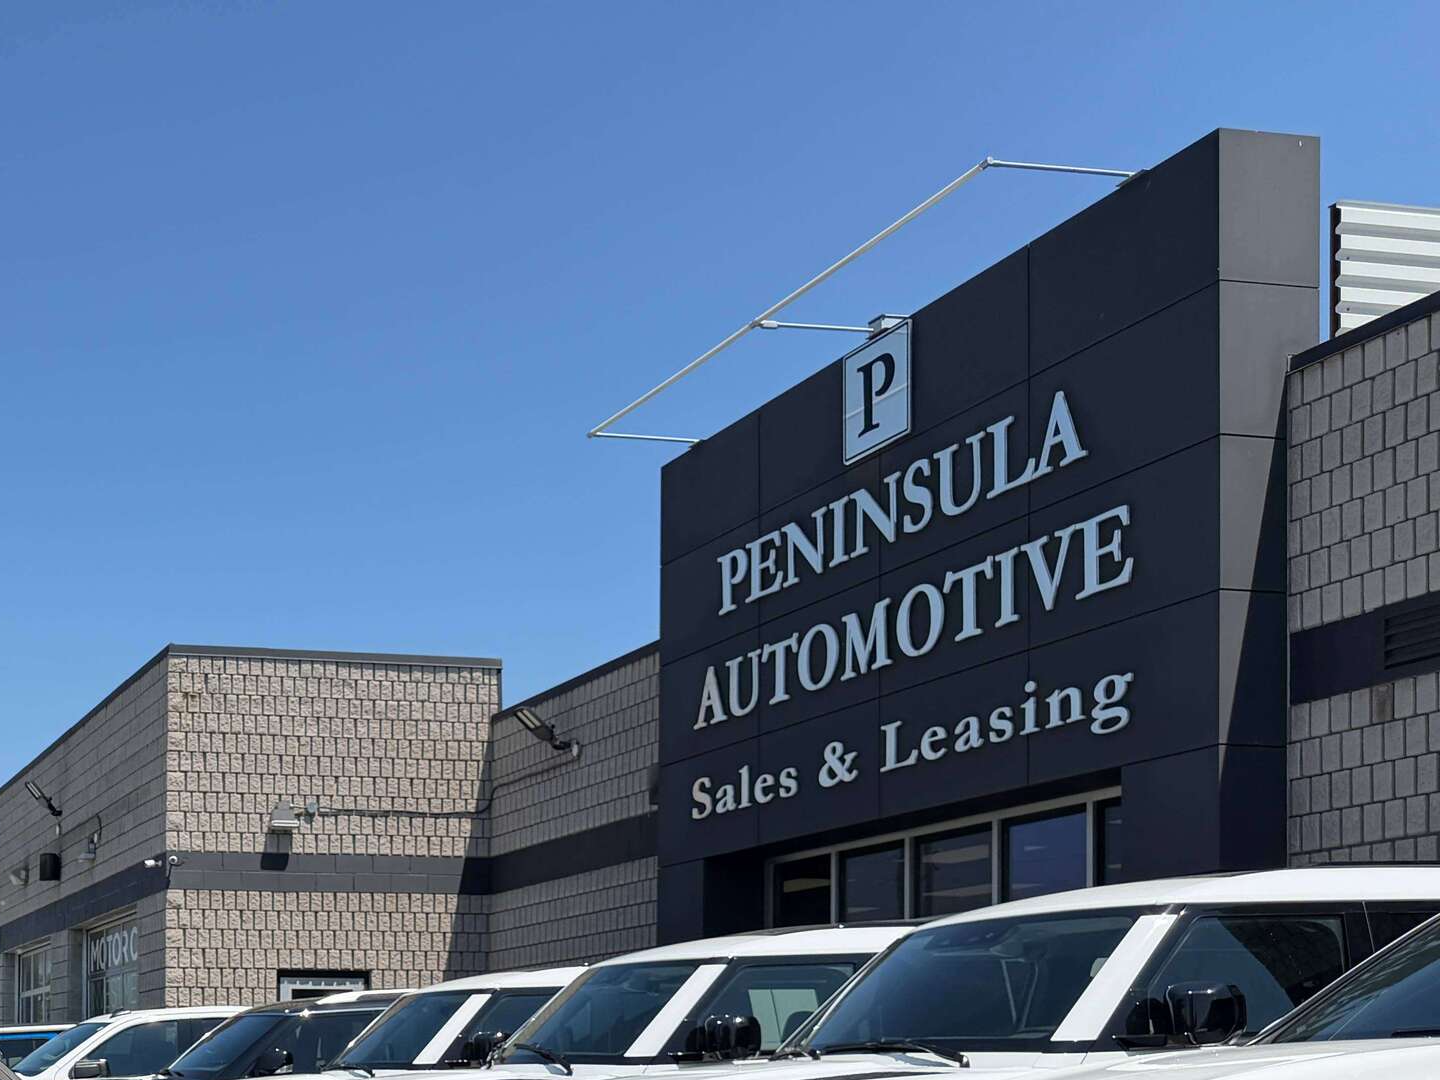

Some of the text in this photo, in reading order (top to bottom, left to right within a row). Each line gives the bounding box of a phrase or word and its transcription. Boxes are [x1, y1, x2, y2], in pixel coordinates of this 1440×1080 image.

[856, 351, 896, 438] P
[717, 390, 1089, 616] PENINSULA
[692, 504, 1135, 730] AUTOMOTIVE
[691, 671, 1135, 820] Sales & Leasing
